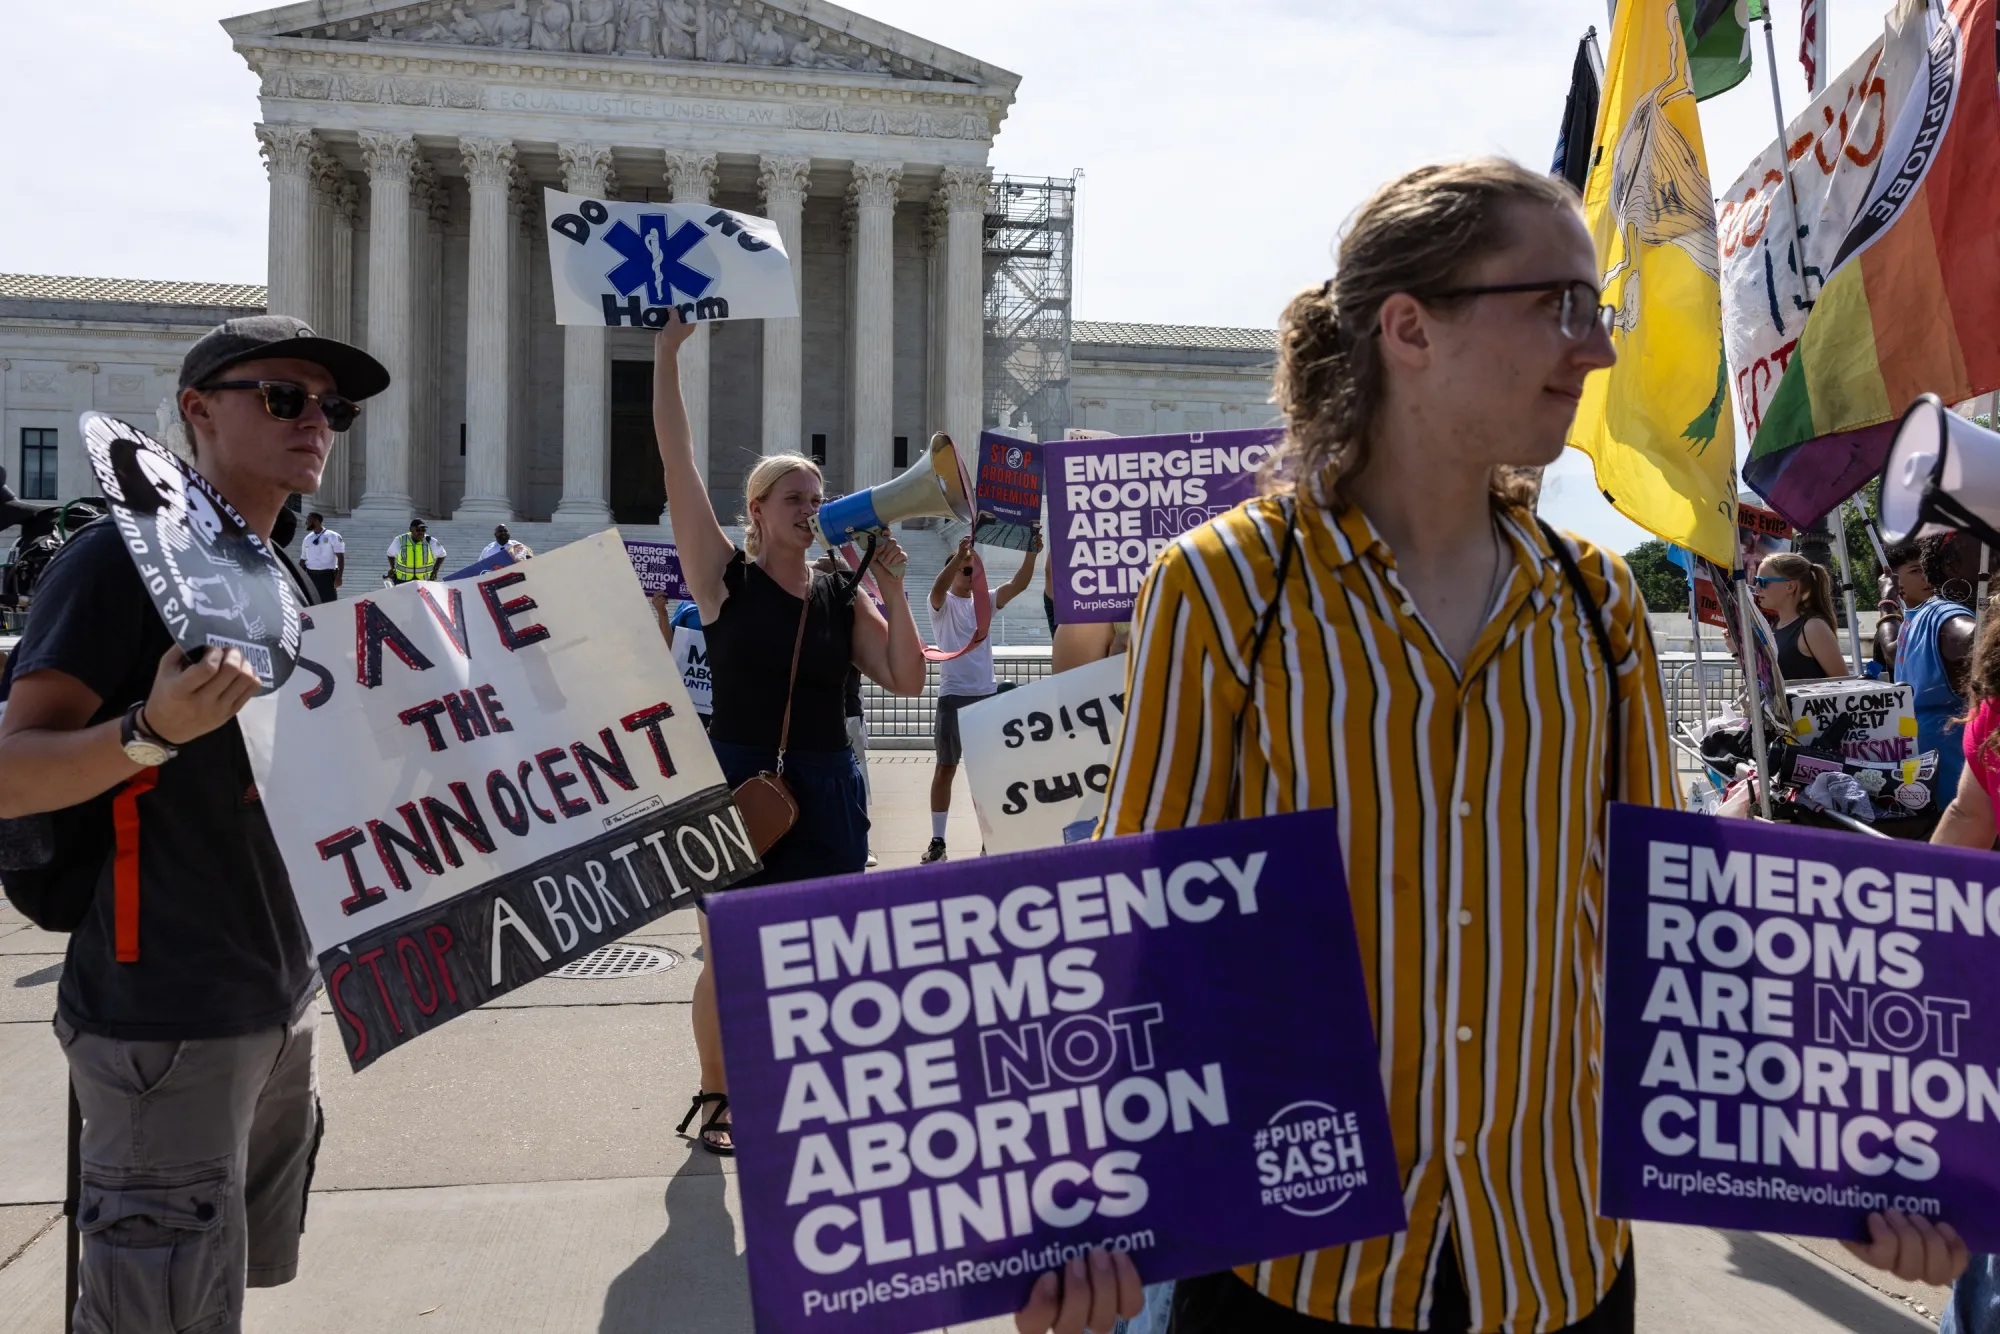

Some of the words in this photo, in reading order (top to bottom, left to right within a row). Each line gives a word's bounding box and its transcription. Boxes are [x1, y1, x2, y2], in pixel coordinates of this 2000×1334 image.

[500, 93, 568, 111] EQUAL
[575, 97, 652, 116] JUSTICE
[663, 102, 725, 120] UNDER
[736, 108, 773, 123] LAW
[188, 471, 248, 528] KILLED
[977, 483, 1039, 508] EXTREMISM
[981, 463, 1039, 490] ABORTION
[1066, 478, 1208, 511] ROOMS
[112, 504, 150, 555] OUR
[246, 533, 272, 559] BY
[627, 545, 678, 557] EMERGEN
[1067, 510, 1142, 539] ARE
[140, 562, 168, 596] OF
[299, 572, 551, 710] SAVE
[397, 684, 514, 752] THE
[1801, 696, 1840, 716] AMY
[1845, 690, 1905, 713] CONEY
[1816, 709, 1889, 731] BRETT
[314, 701, 676, 917] INNOCENT
[329, 924, 458, 1062] STOP
[491, 805, 758, 987] ABORTION
[759, 851, 1268, 990] EMERGENCY
[1647, 902, 1924, 989] ROOMS
[767, 947, 1105, 1060] ROOMS
[1641, 966, 1794, 1038] ARE
[1813, 983, 1971, 1057] NOT
[777, 1039, 962, 1133] ARE
[979, 1002, 1163, 1098] NOT
[1640, 1029, 2000, 1123] ABORTION
[786, 1062, 1230, 1206] ABORTION
[1253, 1111, 1360, 1152] #PURPLE
[1256, 1133, 1365, 1187] SASH
[1641, 1094, 1941, 1182] CLINICS
[792, 1150, 1150, 1275] CLINICS
[1261, 1170, 1368, 1206] REVOLUTION
[803, 1228, 1155, 1317] PurpleSashRevolutioncom
